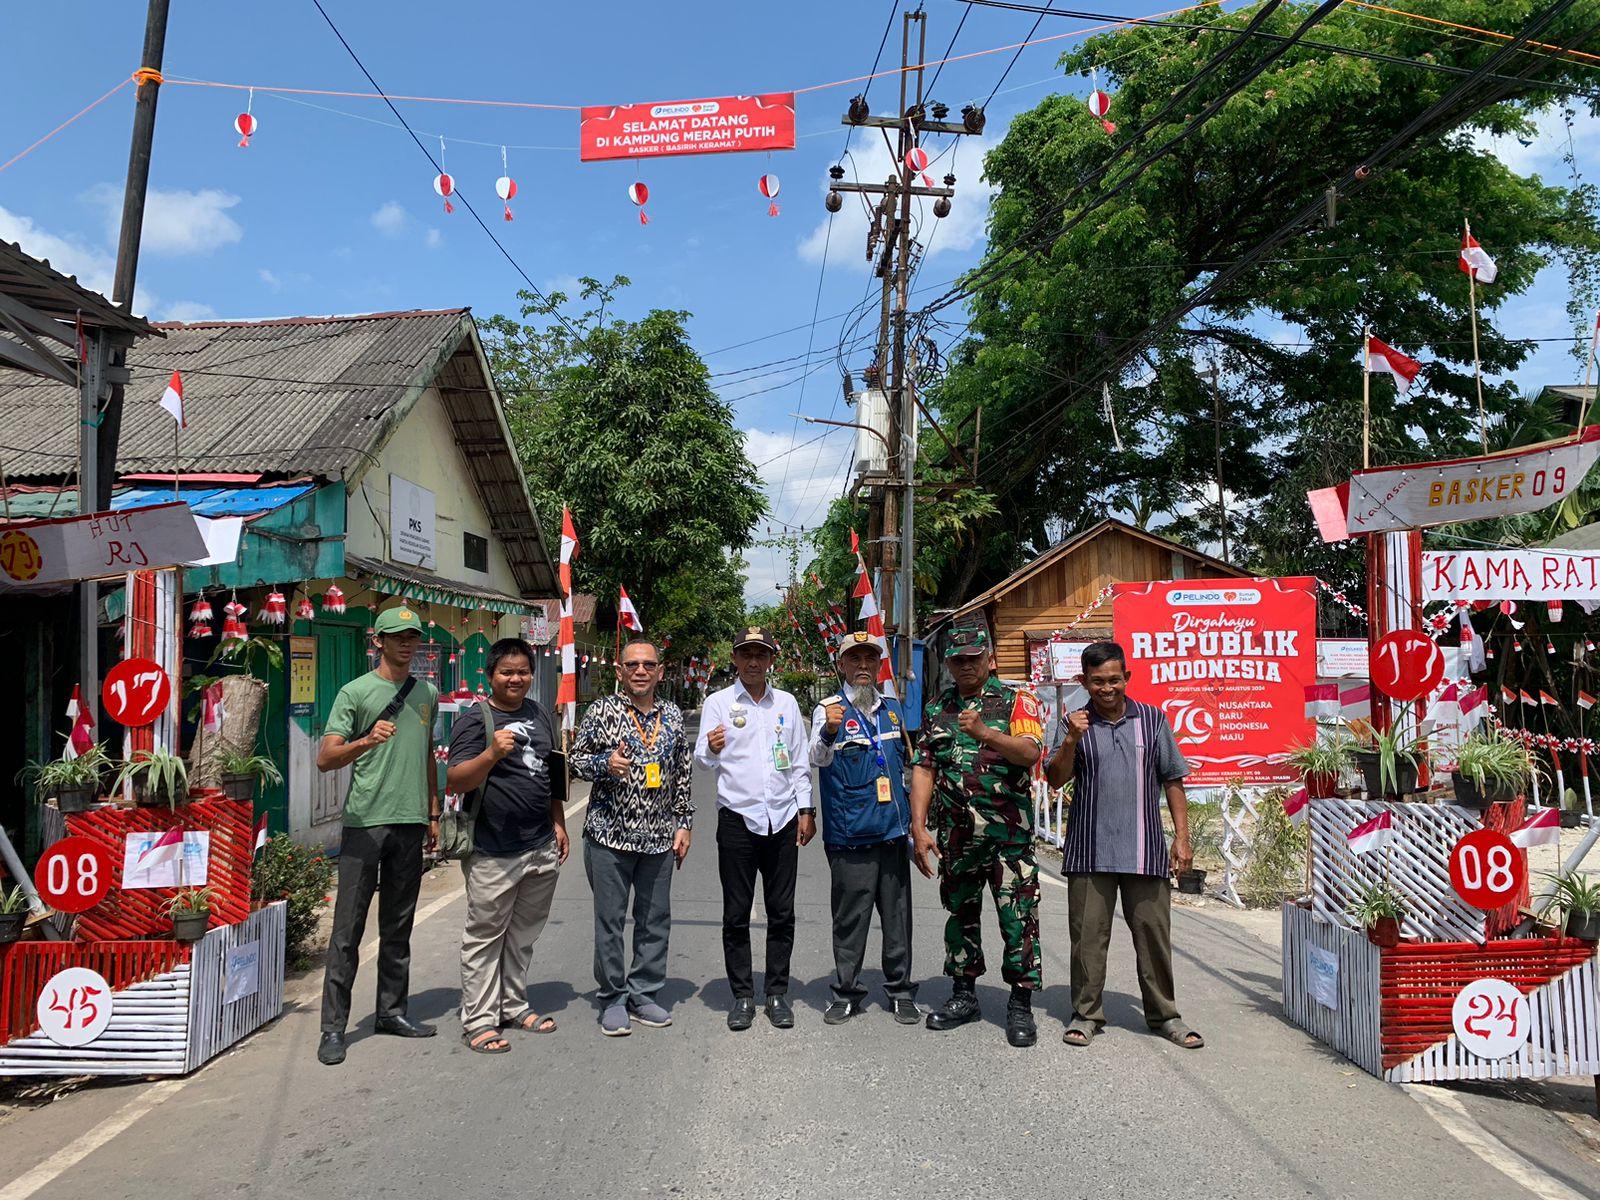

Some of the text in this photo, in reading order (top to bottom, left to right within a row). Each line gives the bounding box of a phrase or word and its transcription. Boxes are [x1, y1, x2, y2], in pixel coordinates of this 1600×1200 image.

[596, 126, 775, 147] DI KAMPUNG MERAH PUTIH
[622, 115, 748, 133] SELAMAT DATANG
[628, 145, 659, 154] BASKER
[699, 141, 736, 150] KERAMAT
[1354, 474, 1416, 525] Kawasan
[1429, 466, 1566, 507] BASKER 09
[88, 514, 132, 539] HUT
[408, 517, 422, 533] PKS
[3, 541, 34, 571] 79
[1183, 593, 1220, 601] PELINDO
[1171, 612, 1256, 633] Dirgahayu
[1131, 630, 1299, 659] REPUBLIK
[1151, 659, 1282, 684] INDONESIA
[1376, 640, 1438, 685] 17
[110, 670, 162, 716] 17
[1219, 701, 1272, 709] NUSANTARA
[1219, 733, 1245, 741] MAJU
[47, 853, 98, 896] 08
[1459, 845, 1513, 892] 08
[49, 985, 102, 1029] 45
[1464, 994, 1519, 1040] 24
